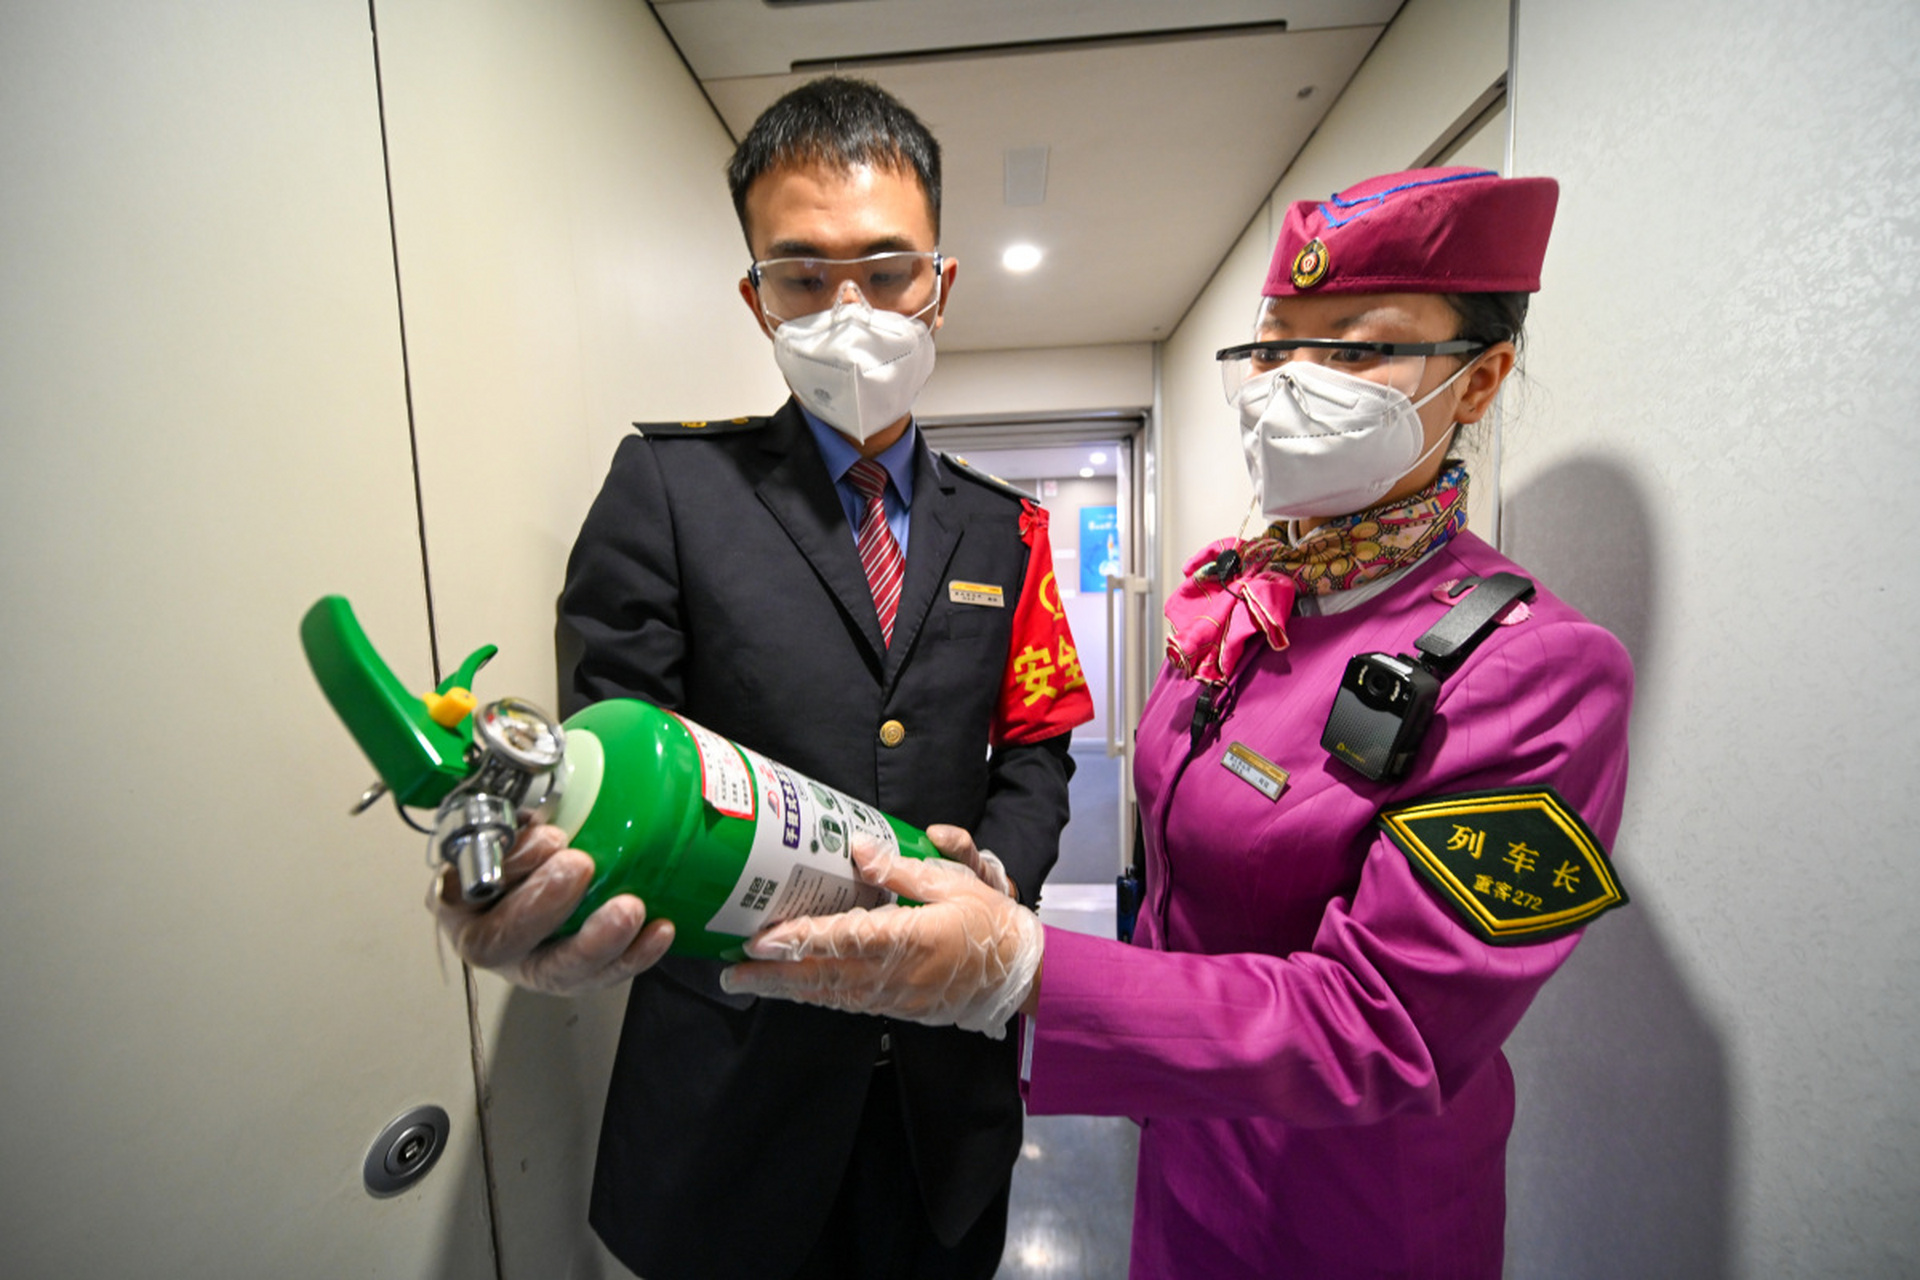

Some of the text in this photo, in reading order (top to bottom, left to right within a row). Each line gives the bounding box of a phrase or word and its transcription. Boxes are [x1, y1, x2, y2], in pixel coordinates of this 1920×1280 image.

[1013, 635, 1086, 707] 安全
[1447, 824, 1580, 893] 列车长
[1473, 874, 1543, 912] 重客272
